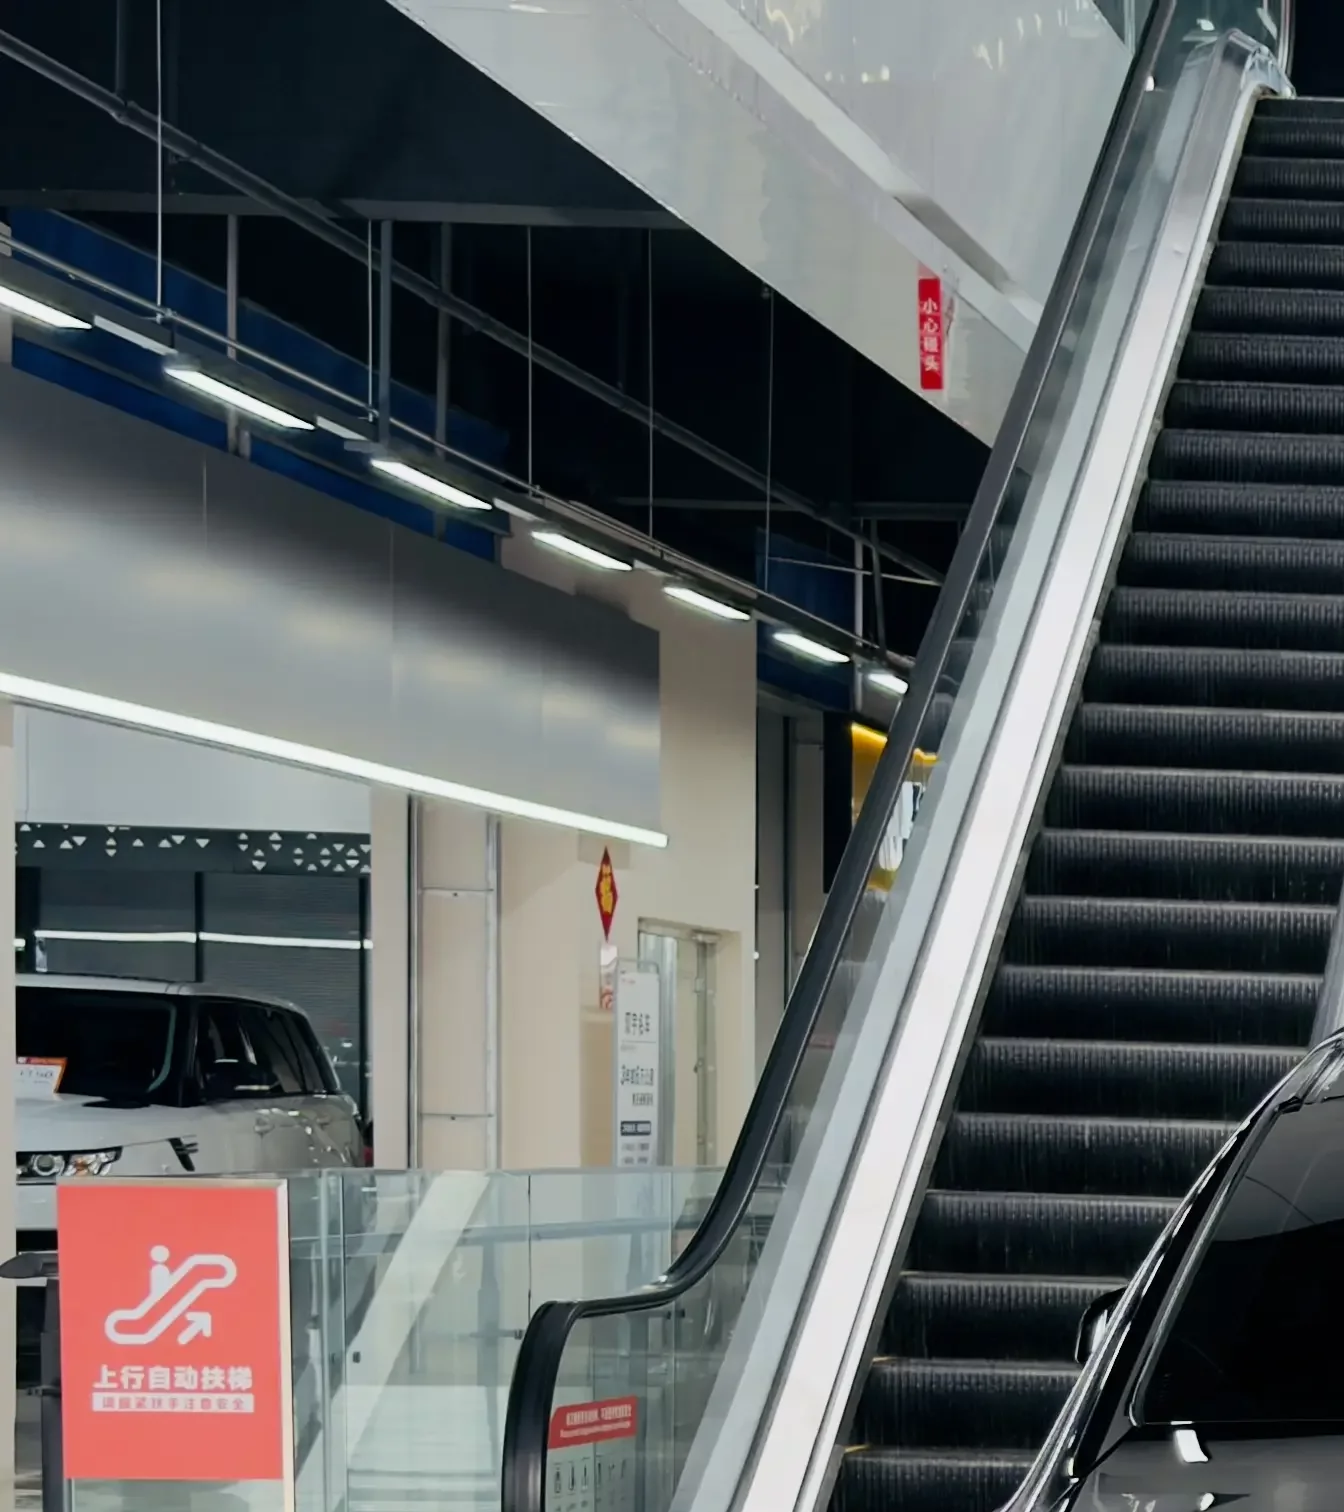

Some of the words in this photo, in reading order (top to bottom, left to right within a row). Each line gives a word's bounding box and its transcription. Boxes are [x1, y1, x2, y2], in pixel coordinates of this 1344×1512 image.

[92, 1364, 253, 1391] 上行自动扶梯
